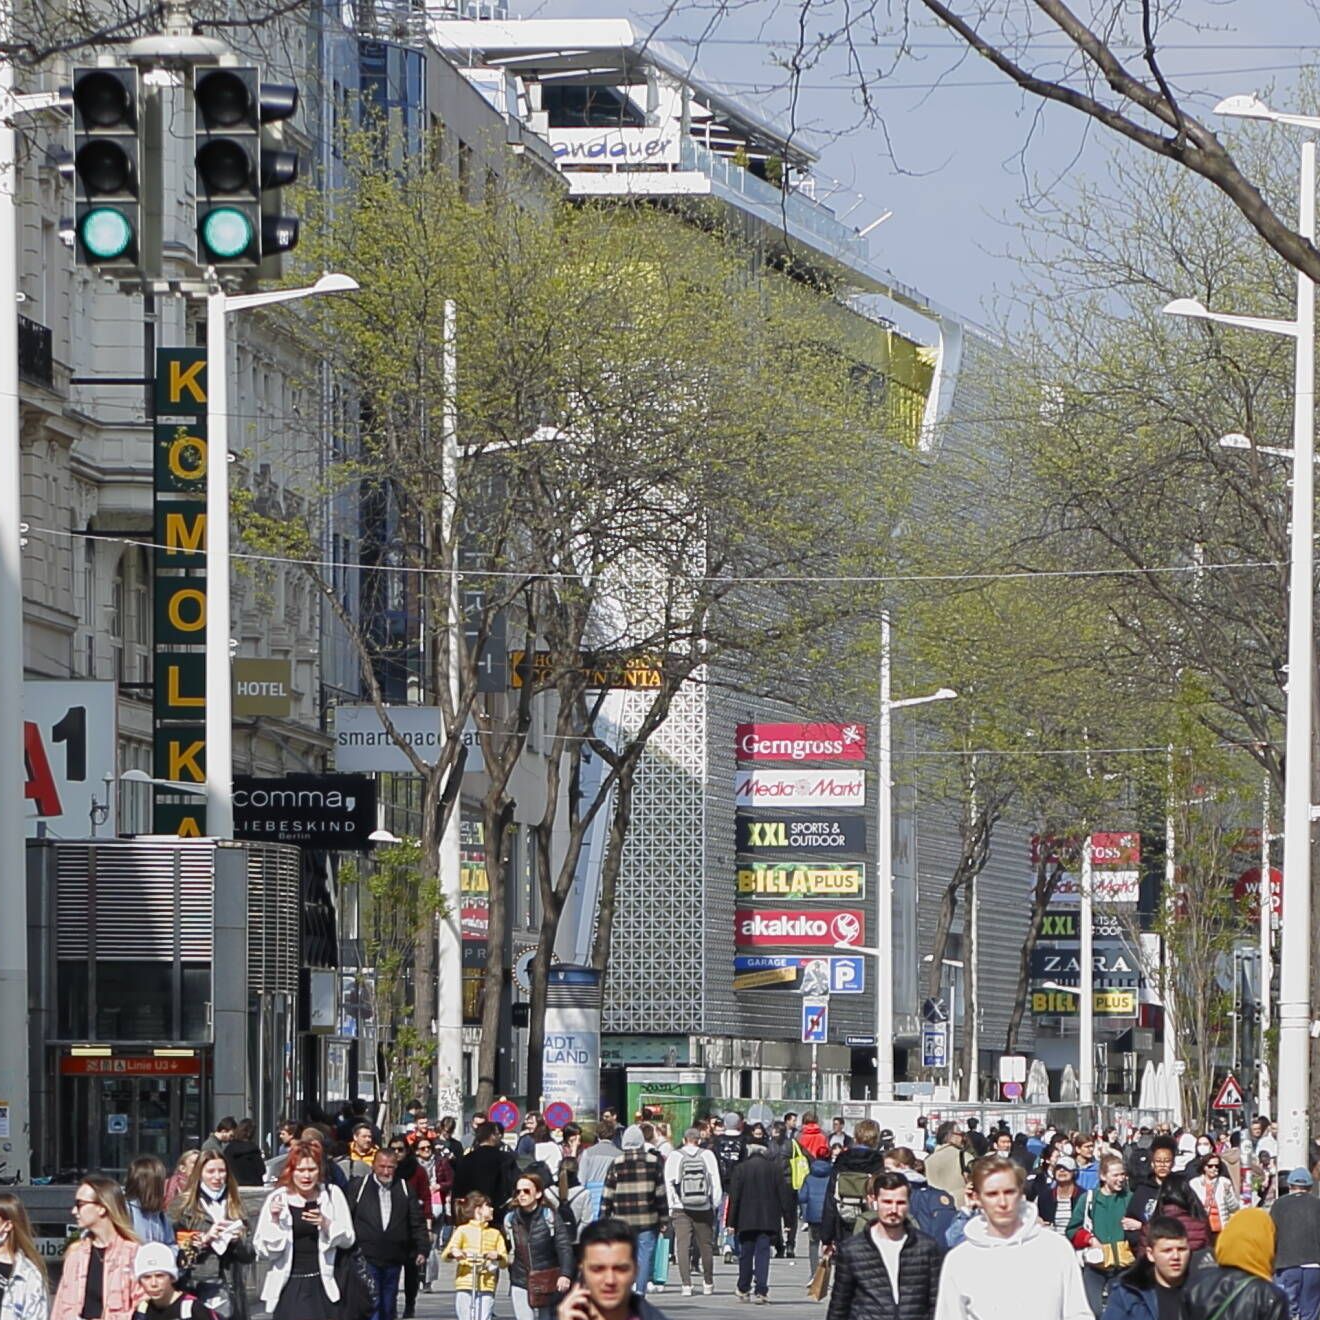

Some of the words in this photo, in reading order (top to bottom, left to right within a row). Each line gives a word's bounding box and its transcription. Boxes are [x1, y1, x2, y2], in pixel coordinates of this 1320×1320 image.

[236, 681, 287, 697] HOTEL
[742, 733, 844, 760] Gerngross
[232, 821, 356, 832] LIEBESKIND
[747, 822, 789, 847] XXL
[790, 822, 829, 834] SPORTS
[831, 822, 841, 834] &
[790, 834, 846, 847] OUTDOOR
[738, 869, 808, 893] BILLA
[814, 875, 855, 888] PLUS
[741, 914, 828, 936] akakiko
[1041, 916, 1076, 935] XXL
[747, 958, 787, 967] GARAGE
[1043, 956, 1132, 973] ZARA
[835, 966, 856, 990] P
[1095, 994, 1130, 1008] PLUS
[127, 1060, 152, 1070] Linie
[154, 1060, 169, 1070] U3
[545, 1050, 589, 1064] LAND
